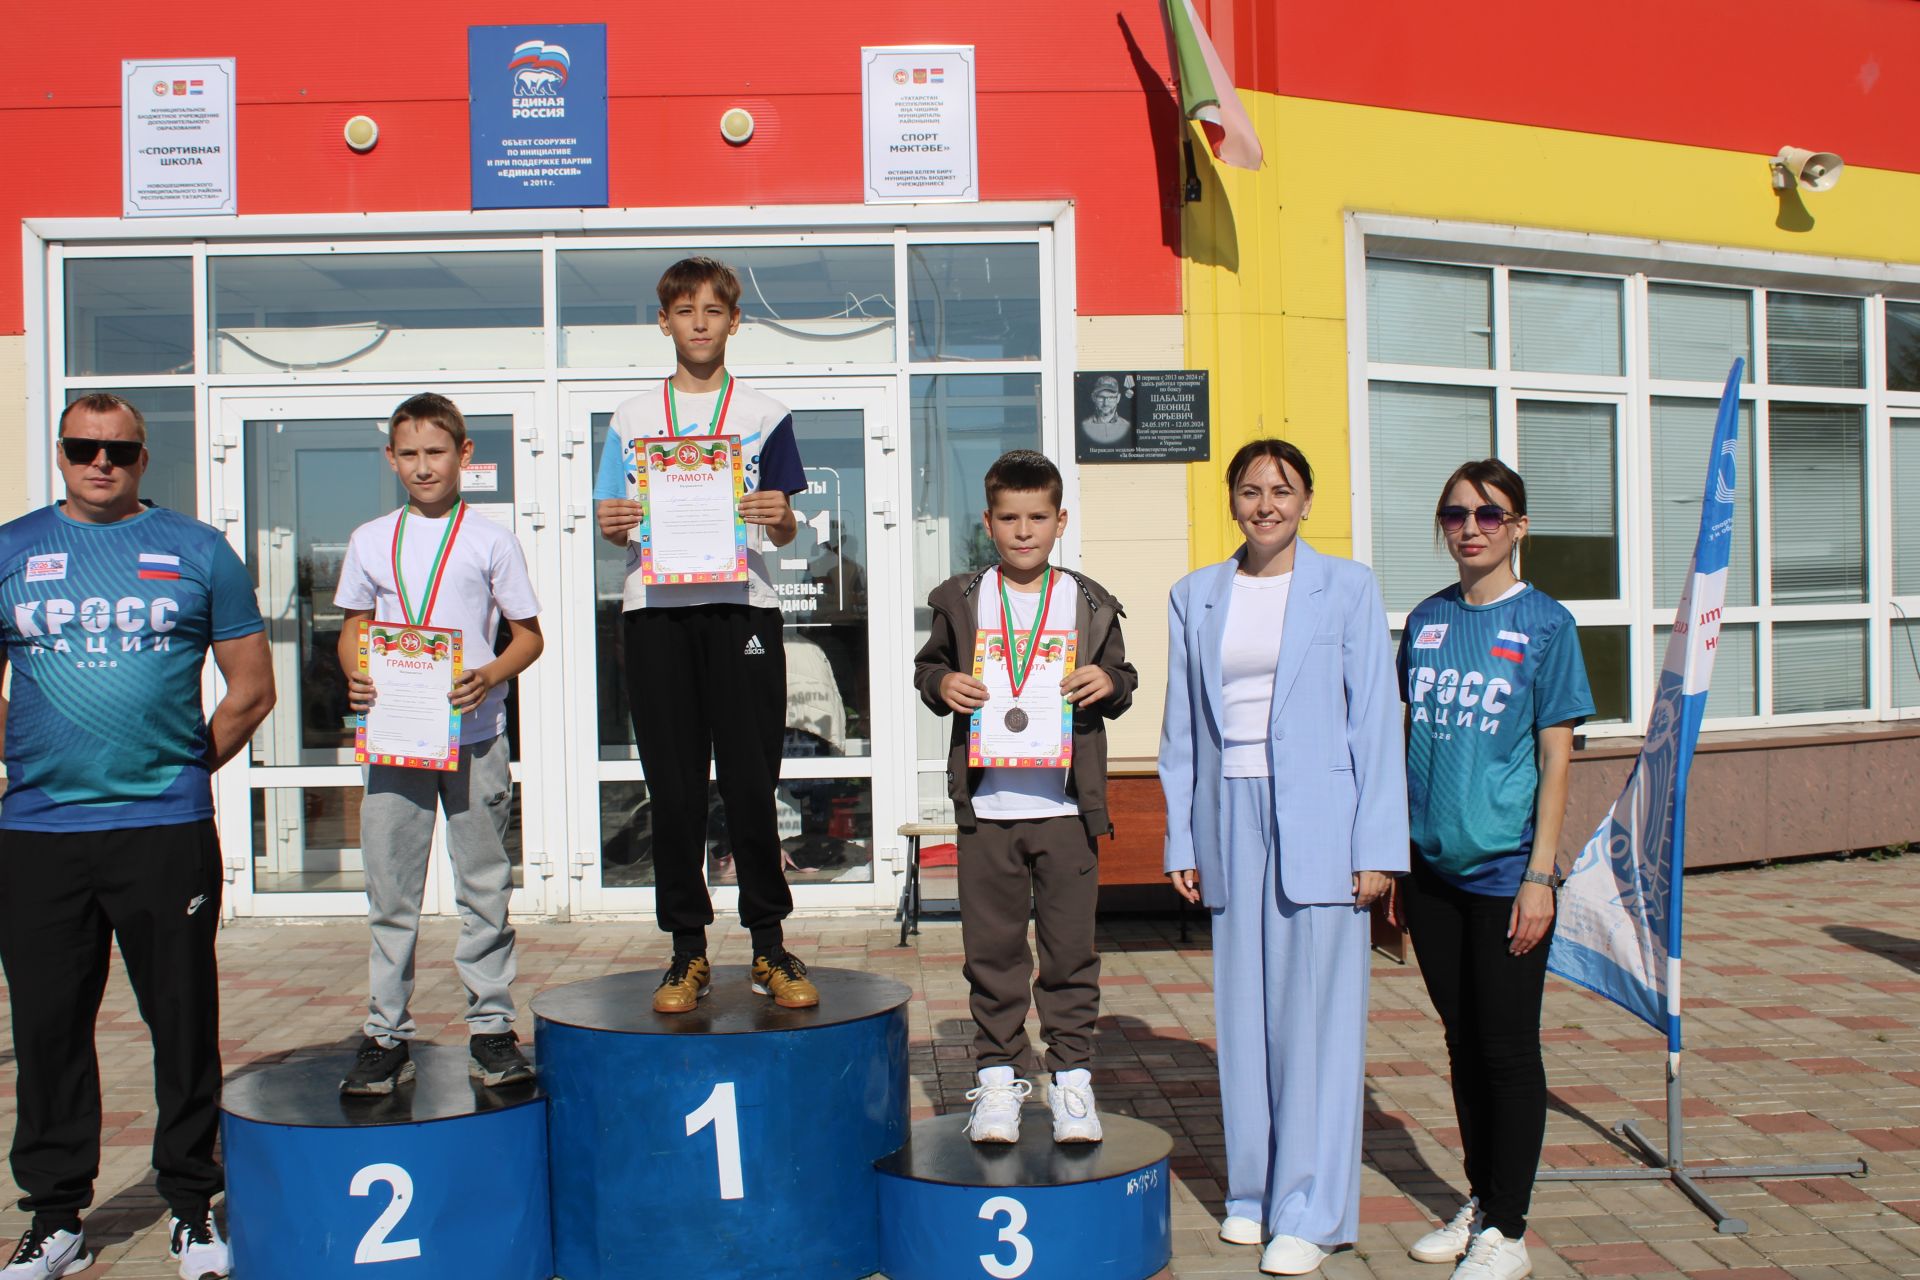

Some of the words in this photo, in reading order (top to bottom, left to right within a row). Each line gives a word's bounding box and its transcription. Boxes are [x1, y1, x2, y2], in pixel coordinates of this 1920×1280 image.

[512, 98, 564, 108] ЕДИНАЯ
[512, 108, 564, 118] РОССИЯ
[534, 138, 576, 146] СООРУЖЕН
[901, 133, 938, 142] СПОРТ
[139, 146, 220, 155] «СПОРТИВНАЯ
[520, 148, 571, 157] ИНИЦИАТИВЕ
[160, 157, 203, 166] ШКОЛА
[512, 158, 560, 167] ПОДДЕРЖКЕ
[561, 157, 592, 165] ПАРТИИ
[498, 169, 540, 178] «ЕДИНАЯ
[541, 168, 581, 177] РОССИЯ»
[1150, 394, 1195, 402] ШАБАЛИН
[1155, 403, 1190, 412] ЛЕОНИД
[1152, 412, 1193, 420] ЮРЬЕВИЧ
[666, 473, 714, 483] ГРАМОТА
[773, 583, 824, 596] РЕСЕНЬЕ
[14, 596, 179, 638] КРОСС
[386, 659, 434, 671] ГРАМОТА
[1413, 706, 1500, 735] АЦИИ
[685, 1082, 744, 1200] 1
[348, 1163, 422, 1263] 2
[979, 1196, 1035, 1278] 3
